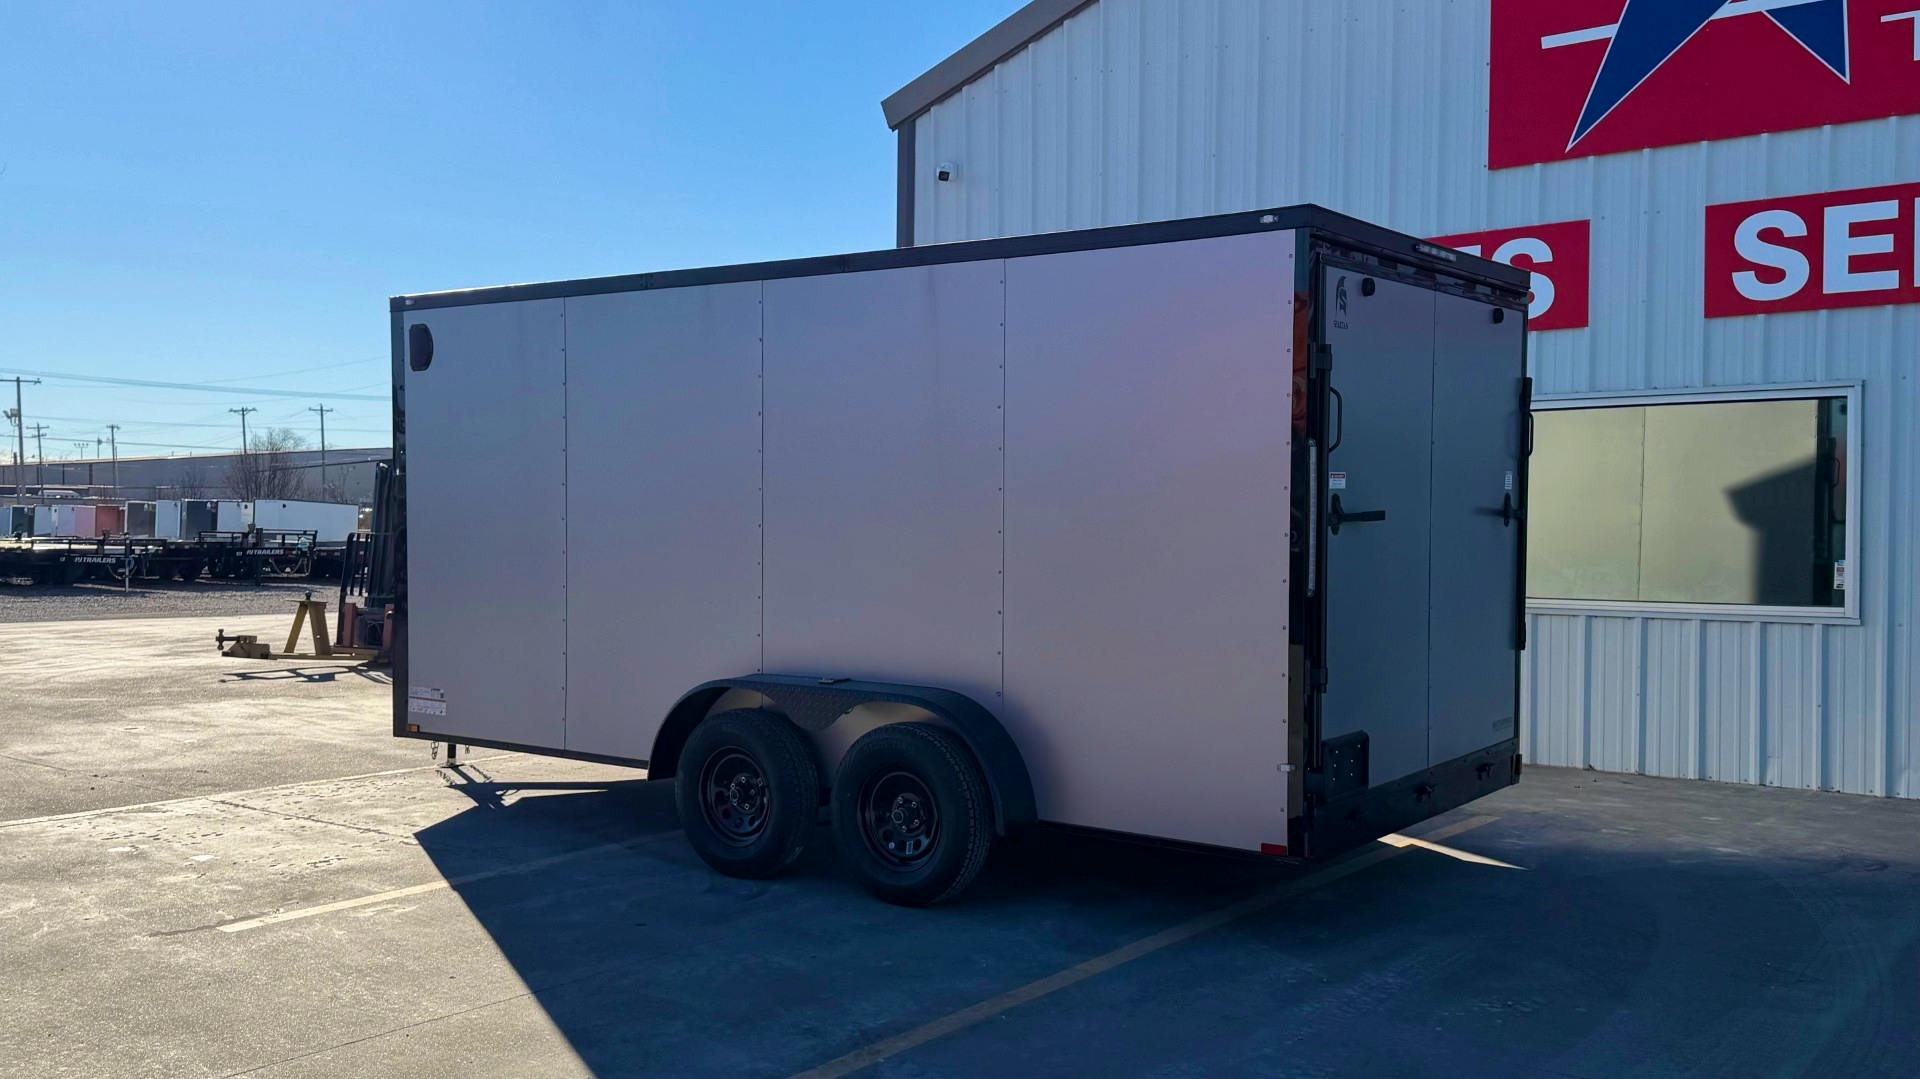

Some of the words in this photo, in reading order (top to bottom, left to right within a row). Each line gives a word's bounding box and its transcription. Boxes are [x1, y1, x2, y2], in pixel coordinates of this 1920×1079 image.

[1731, 196, 1920, 302] SE
[254, 548, 284, 556] TRAILERS
[83, 556, 117, 564] TRAILERS
